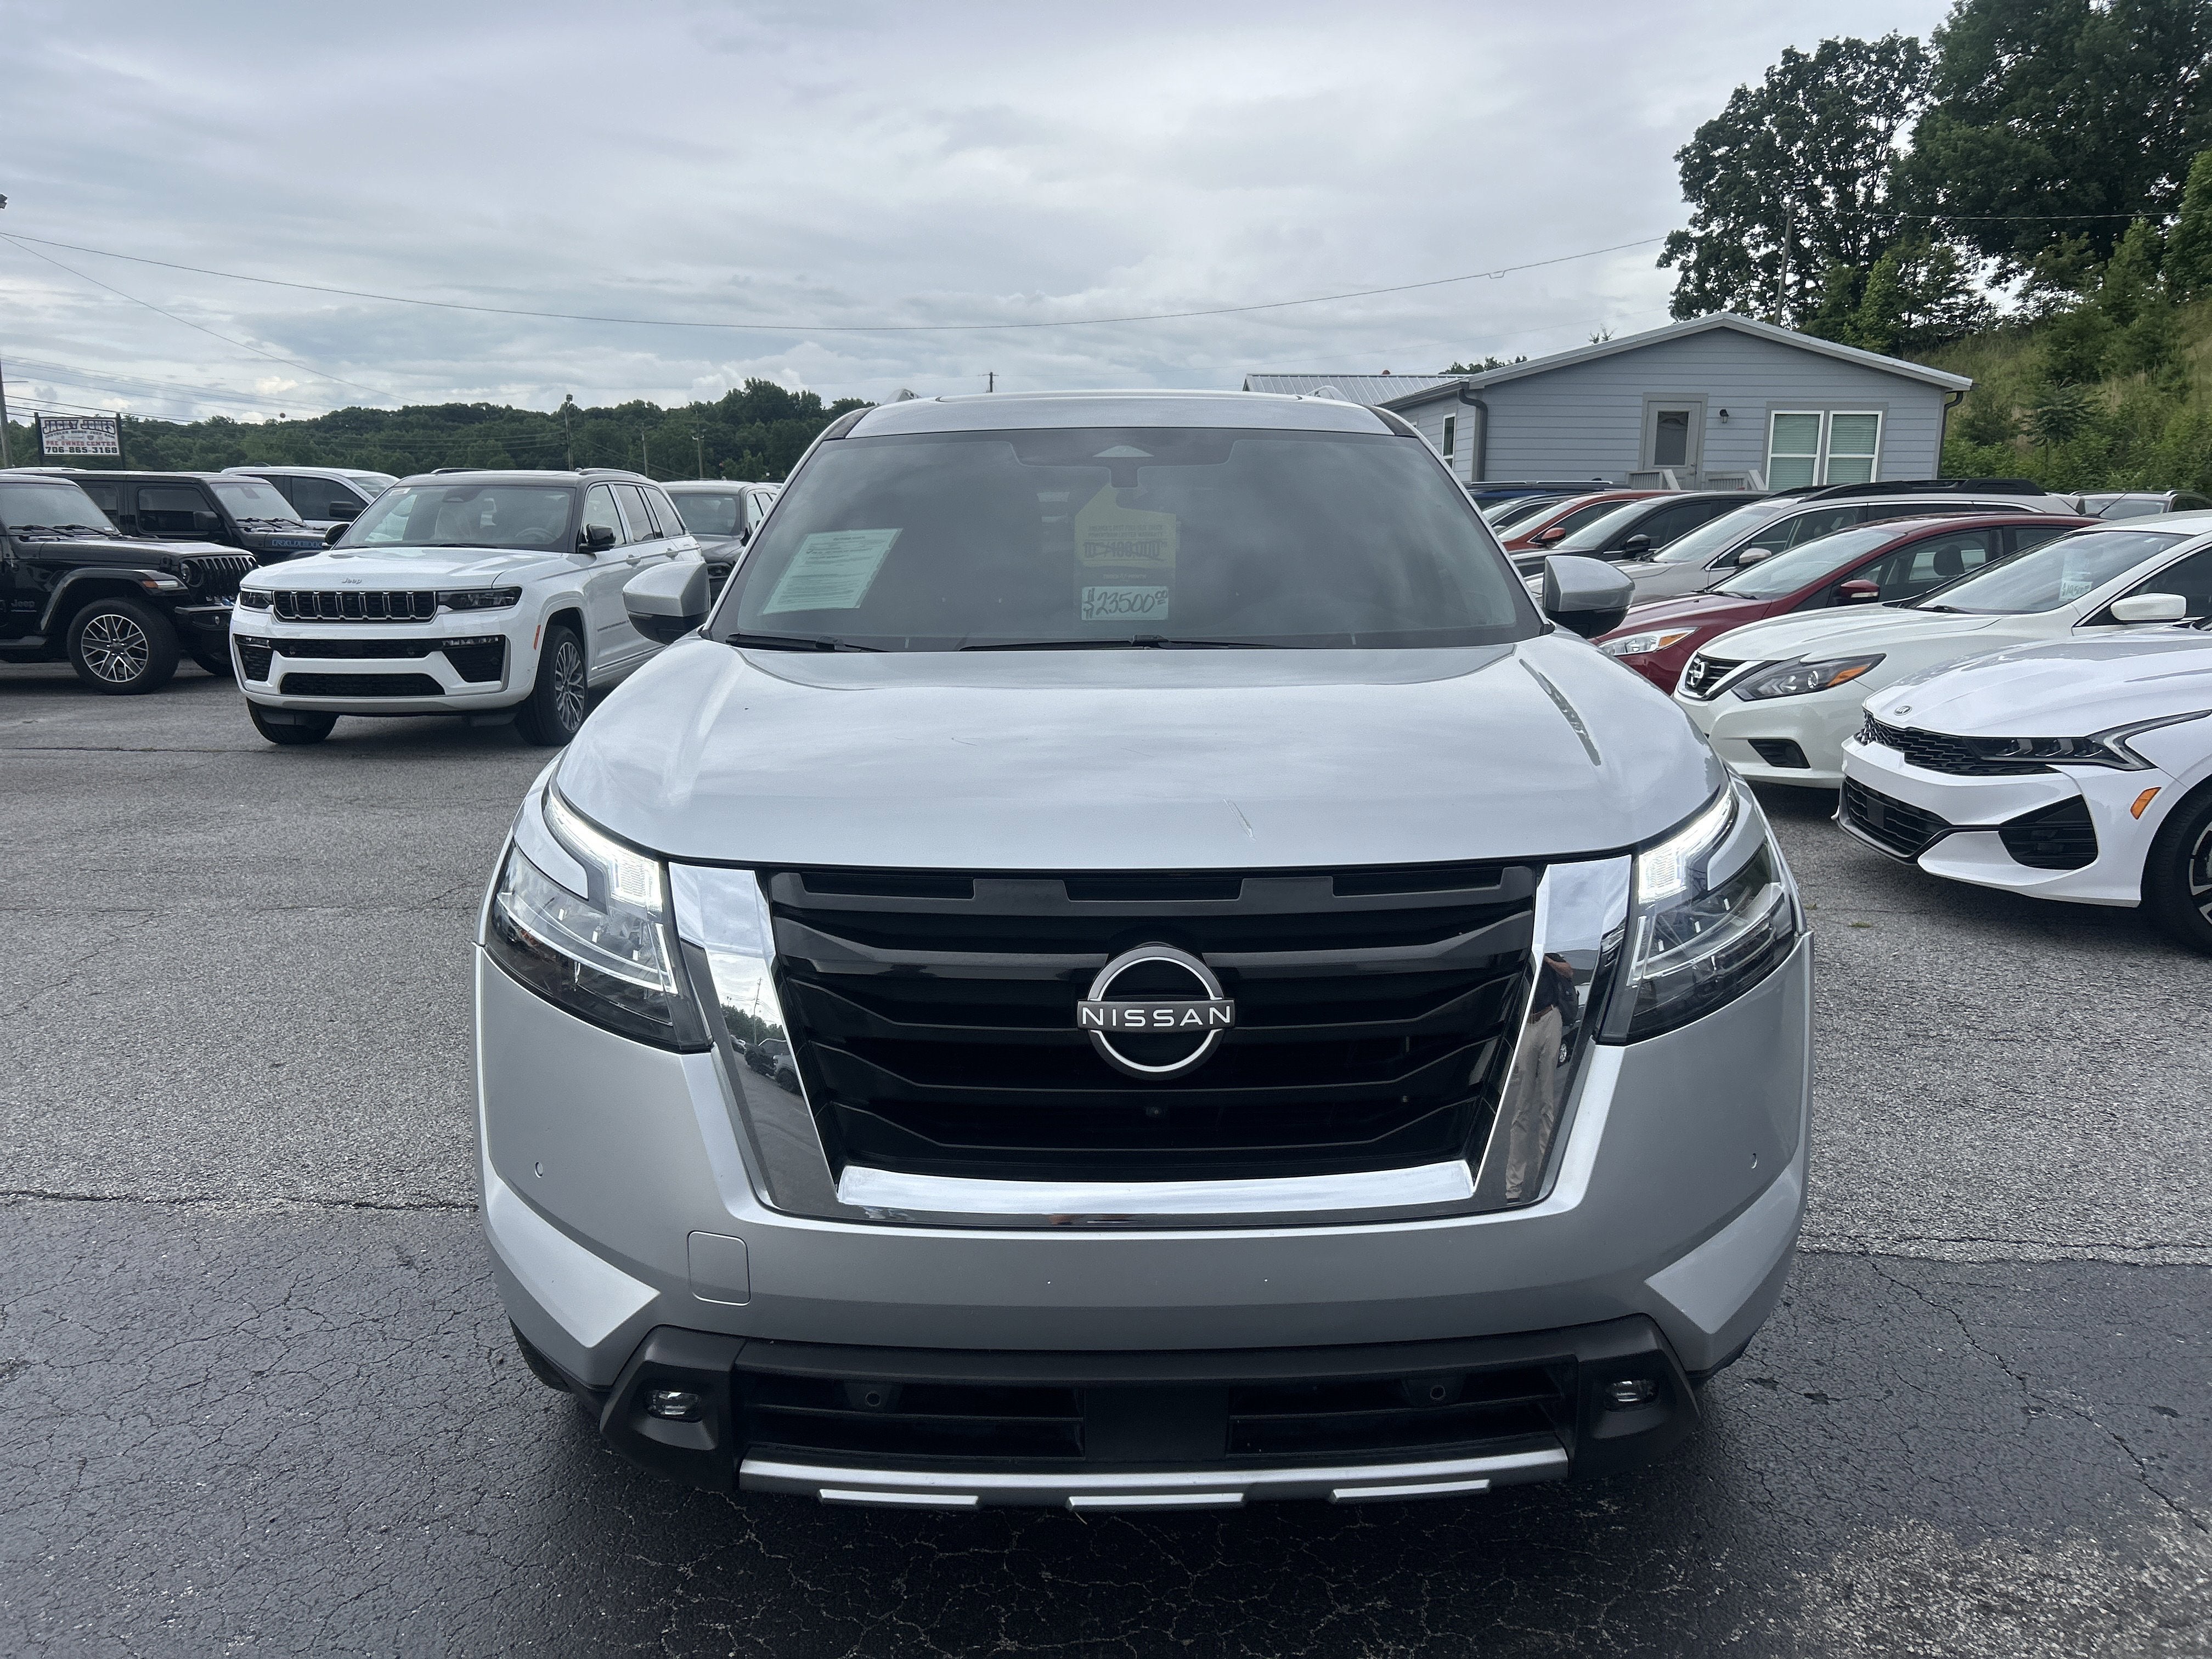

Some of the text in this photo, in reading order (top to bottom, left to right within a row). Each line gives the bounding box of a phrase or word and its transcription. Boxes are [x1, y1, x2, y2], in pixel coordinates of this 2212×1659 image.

[43, 420, 116, 435] JACKY JONES
[1082, 1006, 1230, 1026] NISSAN
